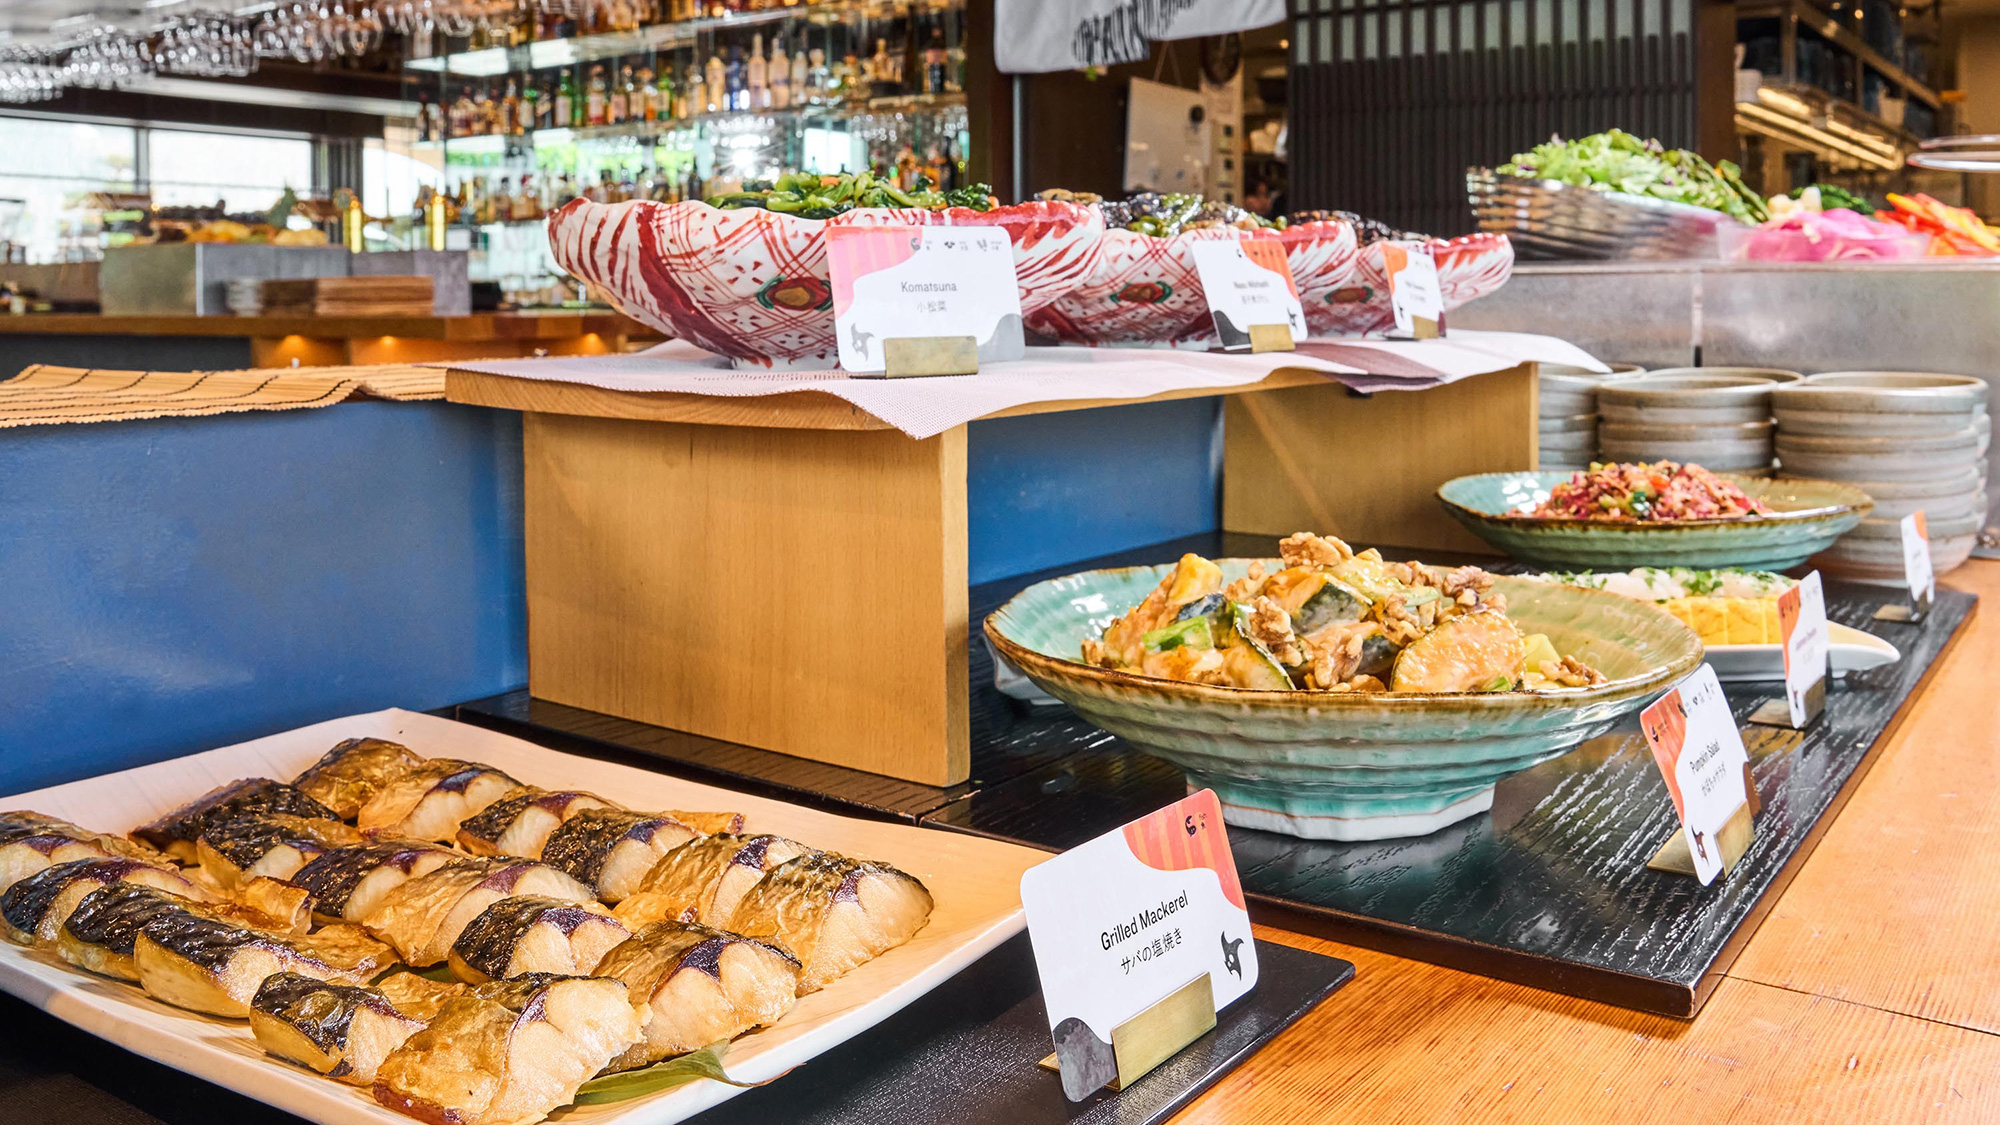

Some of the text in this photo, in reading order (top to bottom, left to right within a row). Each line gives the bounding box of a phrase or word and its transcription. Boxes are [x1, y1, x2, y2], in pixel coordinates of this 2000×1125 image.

[901, 281, 957, 293] Komatsuna
[1101, 889, 1189, 951] Grilled Mackerel
[1121, 927, 1182, 975] サバの塩焼き
